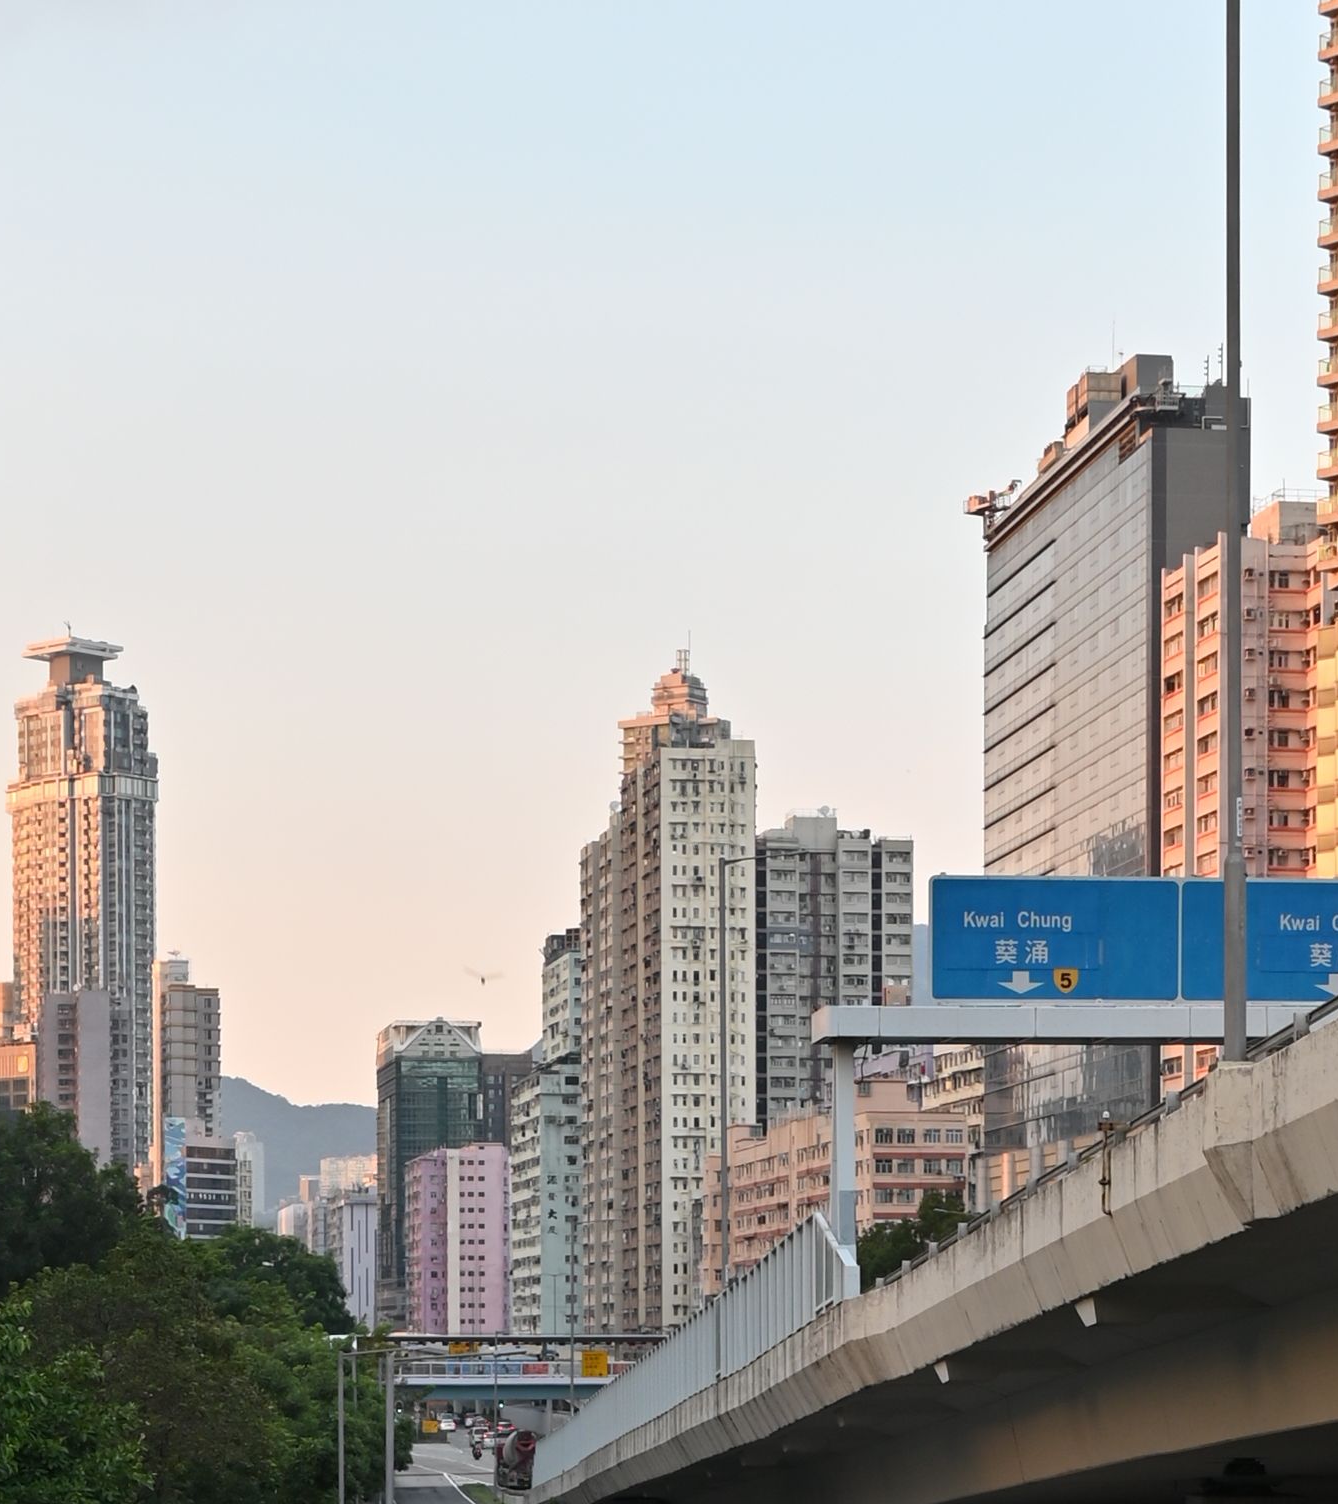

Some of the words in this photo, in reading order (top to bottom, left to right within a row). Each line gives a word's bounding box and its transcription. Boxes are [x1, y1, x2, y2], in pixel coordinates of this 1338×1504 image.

[963, 911, 1005, 929] Kwai
[1017, 911, 1073, 933] Chung
[1279, 914, 1321, 932] Kwai
[994, 939, 1049, 965] 葵涌
[1060, 972, 1072, 989] 5
